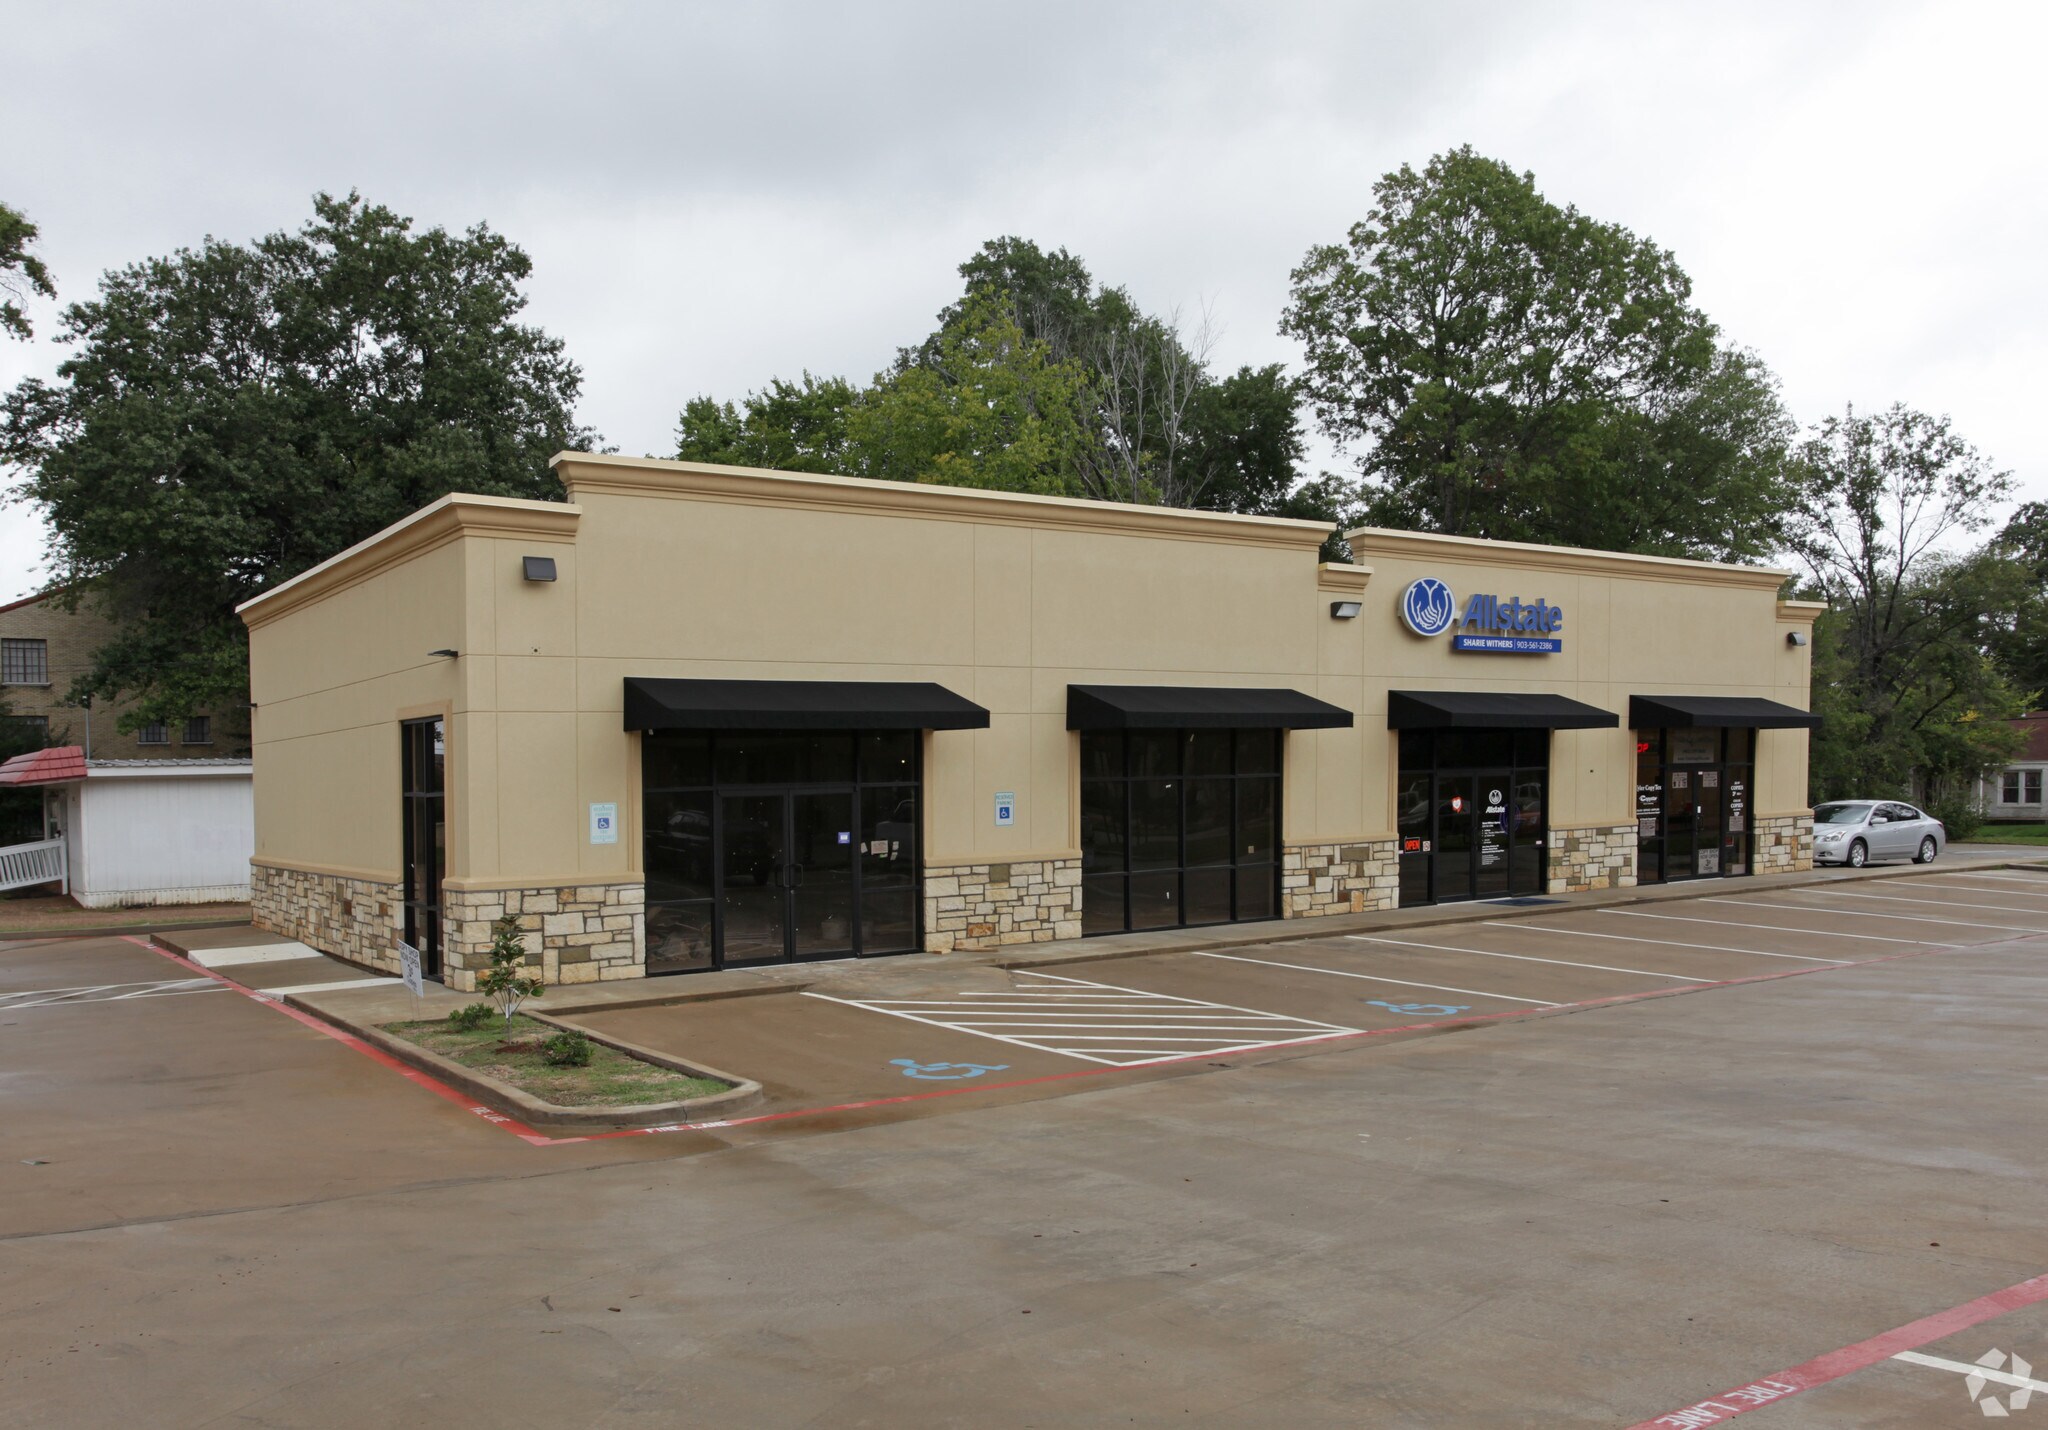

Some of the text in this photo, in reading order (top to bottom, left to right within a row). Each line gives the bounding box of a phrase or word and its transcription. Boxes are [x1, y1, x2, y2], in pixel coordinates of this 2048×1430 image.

[1461, 593, 1563, 632] Allstate
[1463, 638, 1553, 650] SHARIE WITHERS 903-561-2386
[645, 1120, 732, 1133] FIRE LANE
[1654, 1380, 1798, 1430] FIRE LANE
